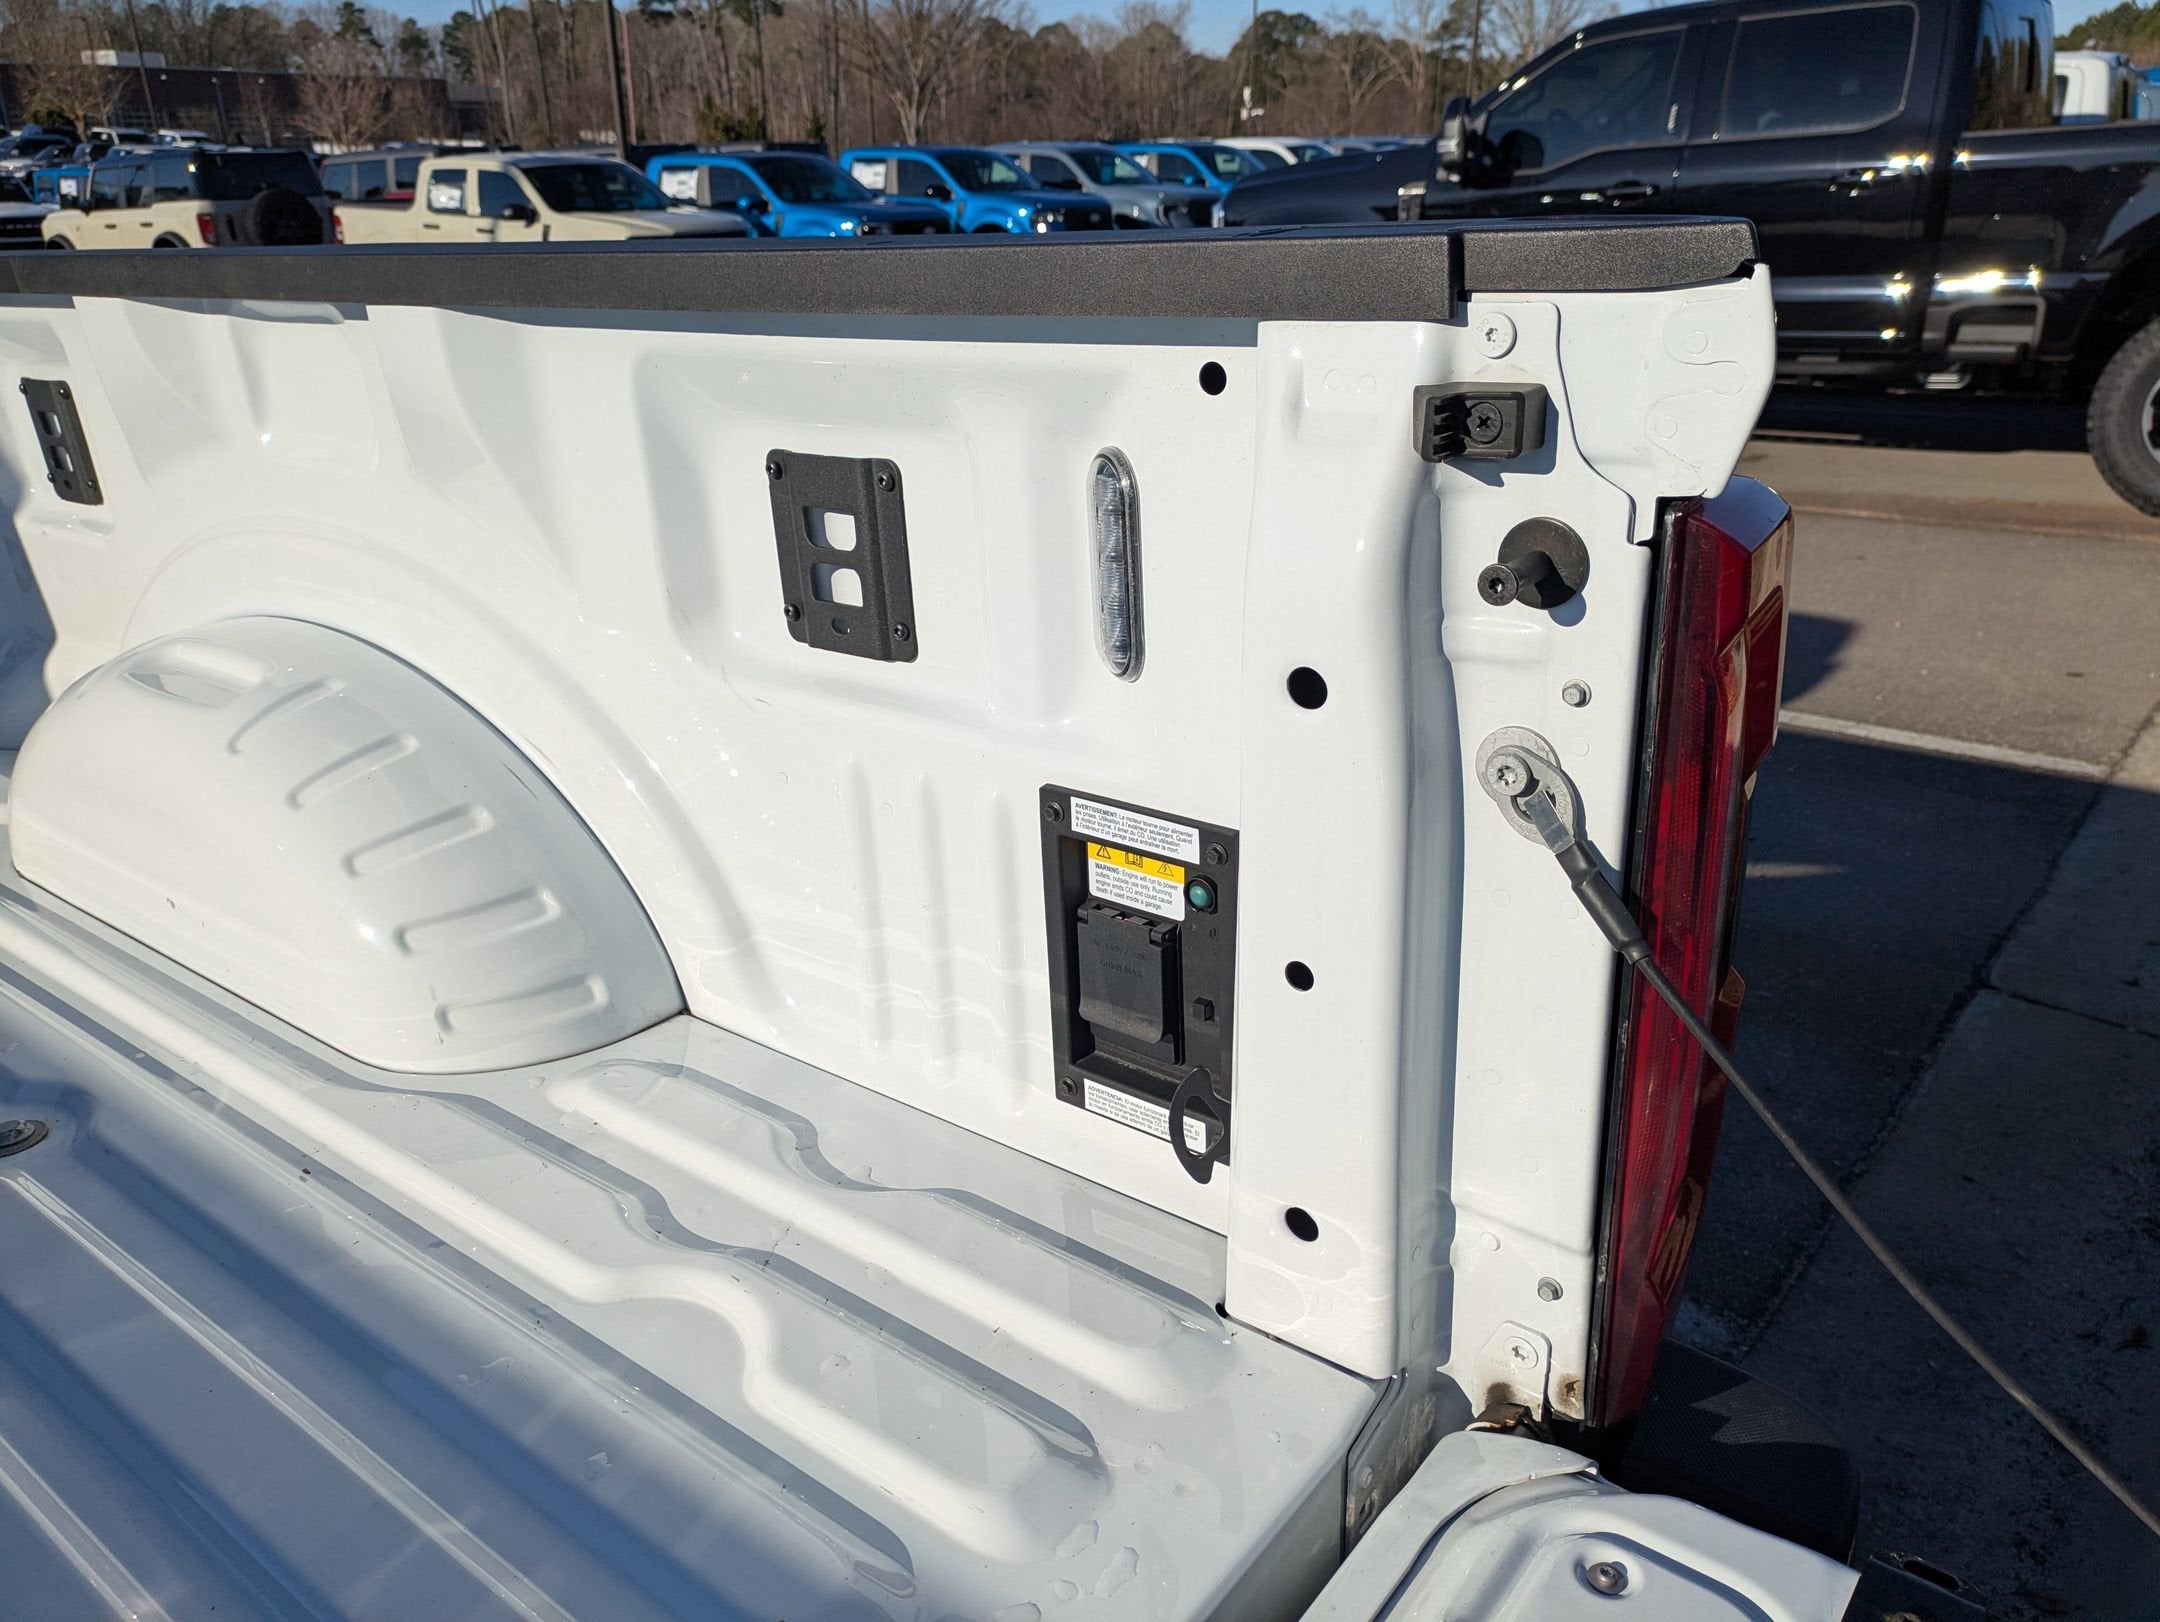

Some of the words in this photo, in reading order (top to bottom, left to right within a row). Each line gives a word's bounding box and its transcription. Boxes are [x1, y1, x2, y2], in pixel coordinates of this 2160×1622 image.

[1075, 802, 1117, 818] AVERTISSEMENT:
[1126, 815, 1141, 824] moteur
[1128, 835, 1138, 844] peut
[1176, 834, 1192, 845] Quand
[1095, 862, 1121, 875] WARNING:
[1122, 870, 1137, 881] Engine
[1163, 882, 1178, 892] power
[1112, 875, 1128, 885] outside
[1151, 886, 1172, 898] Running
[1095, 878, 1110, 889] engine
[1112, 882, 1124, 891] emits
[1125, 886, 1133, 894] CO
[1134, 888, 1143, 897] and
[1144, 891, 1156, 900] could
[1158, 896, 1172, 905] cause
[1096, 885, 1108, 894] death
[1113, 890, 1124, 899] used
[1125, 894, 1139, 903] inside
